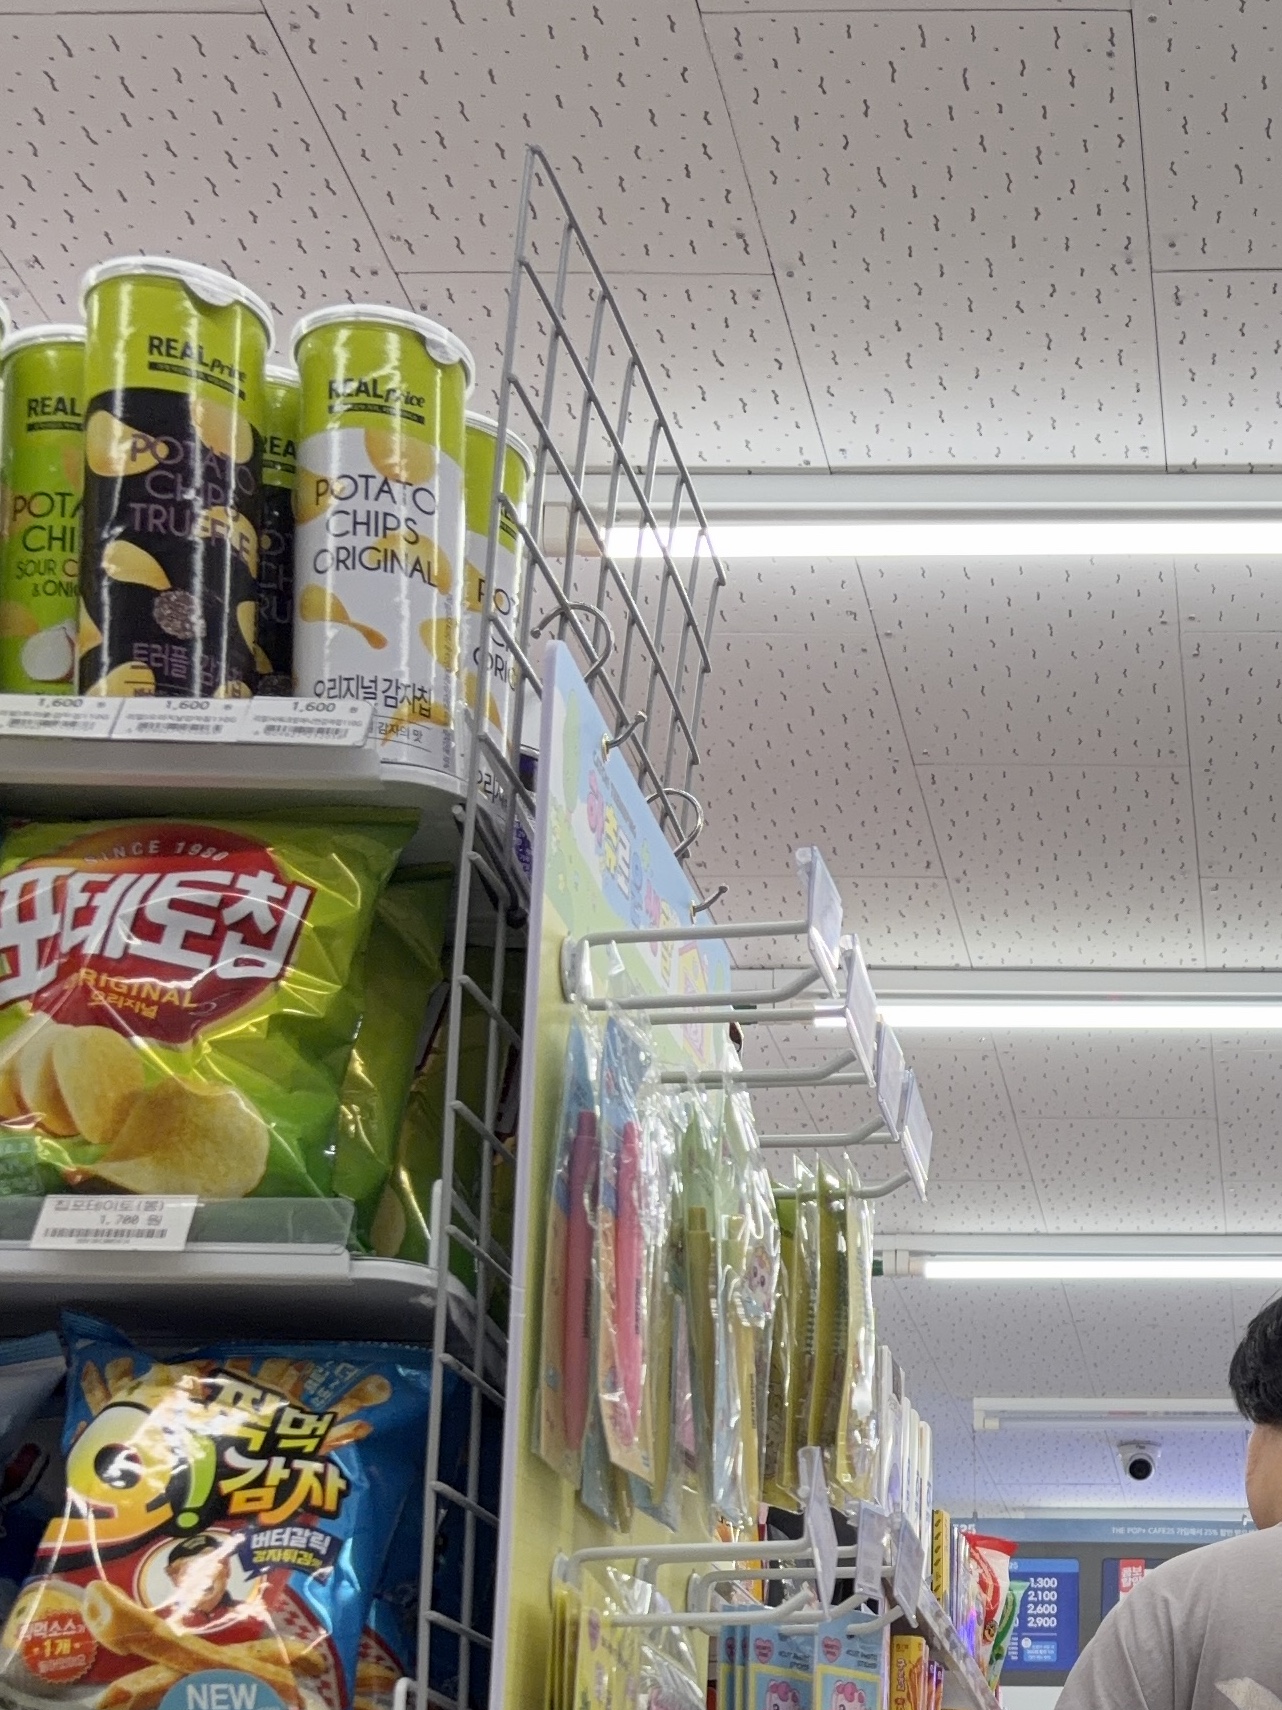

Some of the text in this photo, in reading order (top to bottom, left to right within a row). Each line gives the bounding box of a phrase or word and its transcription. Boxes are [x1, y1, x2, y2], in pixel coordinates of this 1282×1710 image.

[149, 336, 209, 367] REAL
[328, 378, 384, 400] REAL
[27, 397, 82, 417] REAL
[315, 474, 437, 516] POTATO
[325, 510, 420, 545] CHIPS
[313, 546, 438, 588] ORIGINAL
[133, 642, 188, 679] 트러플
[292, 702, 336, 713] 1,600
[313, 674, 434, 719] 오리지널 감자칩
[84, 840, 230, 864] SINCE 1980
[0, 866, 312, 1002] 포테토칩
[218, 1446, 347, 1526] 감자
[252, 1526, 332, 1554] 버터갈릭
[186, 1684, 258, 1710] NEW
